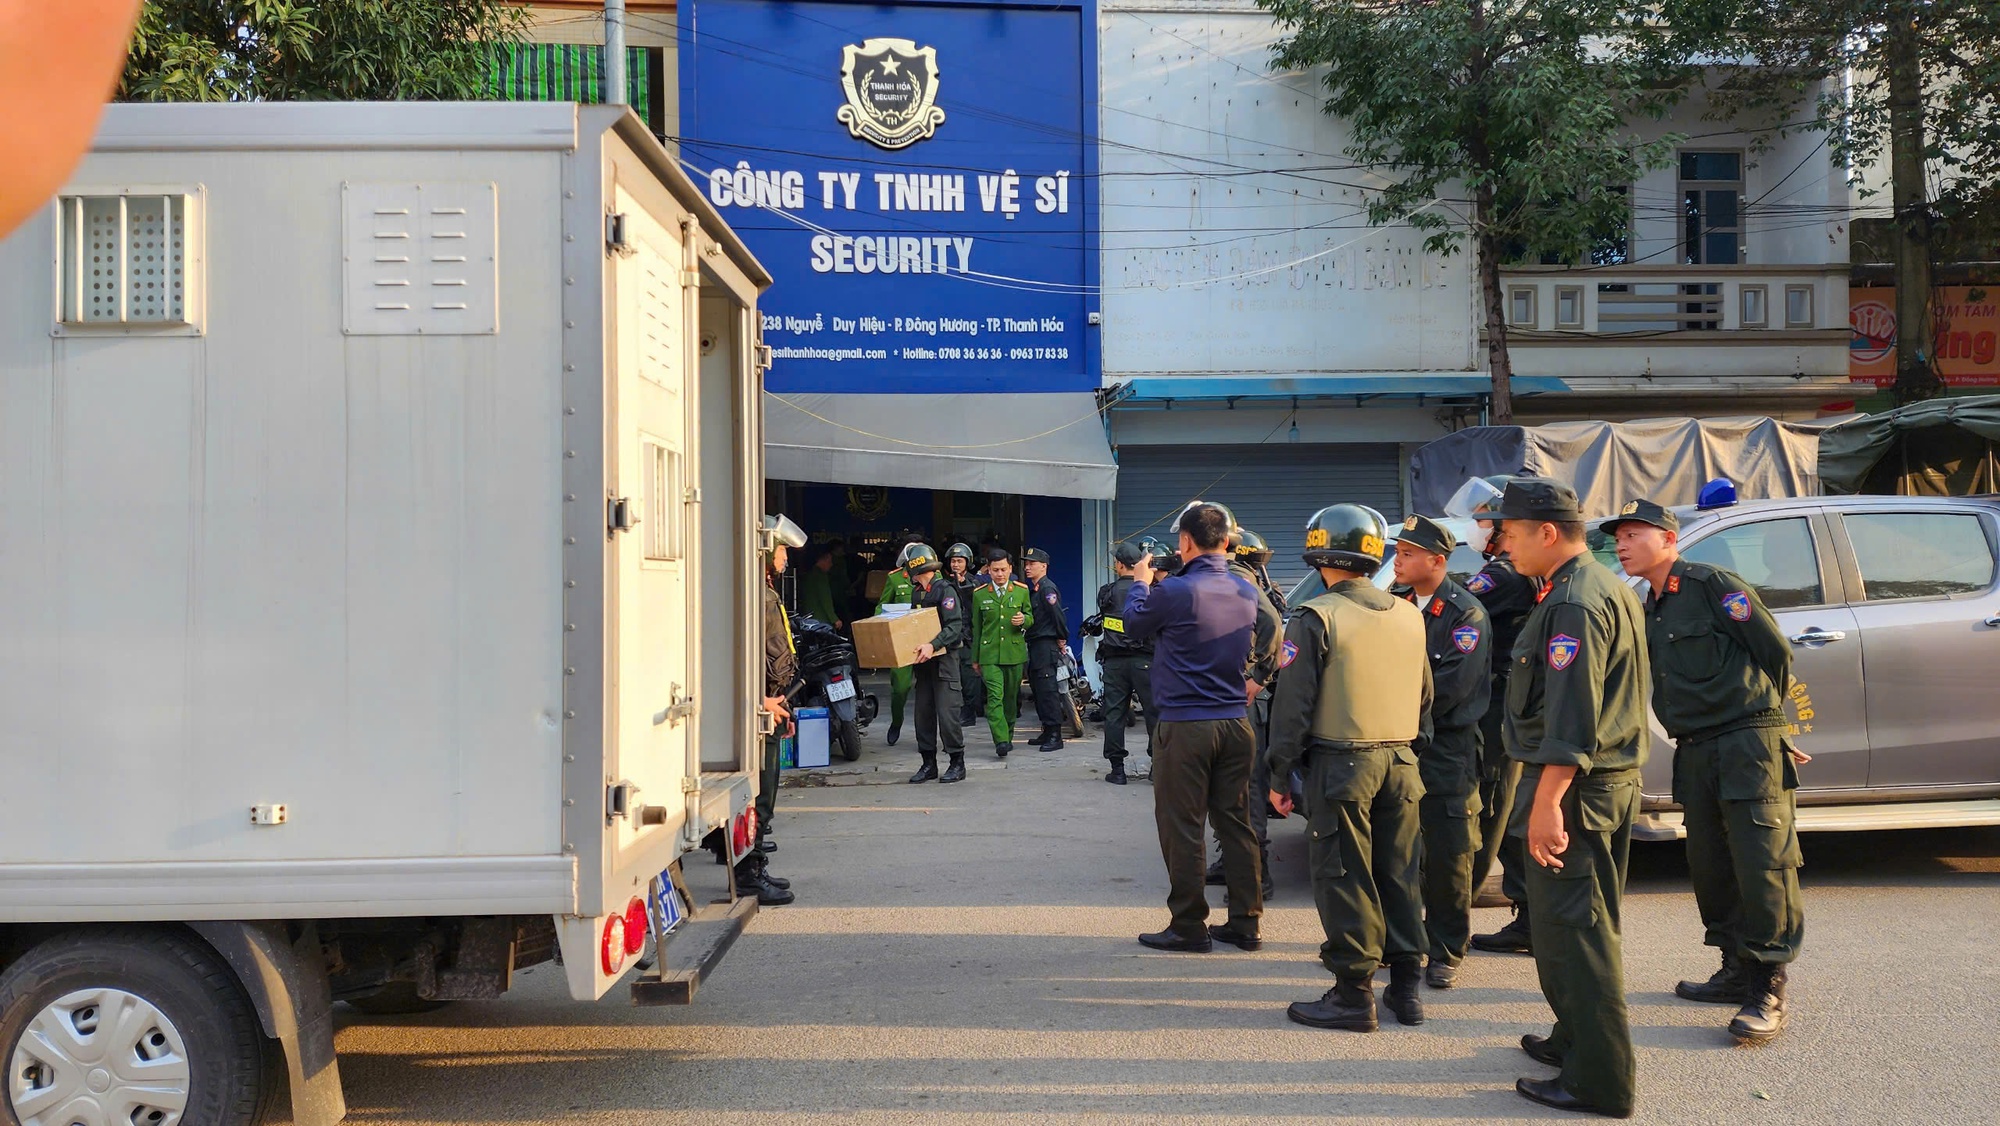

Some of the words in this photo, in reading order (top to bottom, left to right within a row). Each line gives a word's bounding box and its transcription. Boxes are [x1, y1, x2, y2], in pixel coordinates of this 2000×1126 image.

[870, 82, 894, 90] THANH
[874, 93, 909, 101] SECURITY
[885, 117, 898, 125] TH
[710, 160, 804, 209] CÔNG
[818, 172, 861, 210] TY
[874, 173, 965, 212] TNHH
[977, 168, 1021, 220] VỆ
[1035, 169, 1070, 214] SĨ
[811, 235, 974, 274] SECURITY
[762, 315, 782, 331] 238
[833, 317, 856, 335] Duy
[895, 318, 902, 331] P.
[905, 317, 937, 336] Đông
[940, 317, 978, 336] Hương
[1004, 318, 1038, 332] Thanh
[1041, 315, 1064, 332] Hóa
[771, 347, 886, 361] esithanhhoa@gmail.com
[903, 348, 937, 360] Hotline:
[939, 348, 961, 359] 0708
[963, 348, 975, 359] 36
[977, 348, 989, 359] 36
[990, 348, 1002, 359] 36
[1010, 348, 1034, 359] 0963
[1035, 348, 1043, 359] 17
